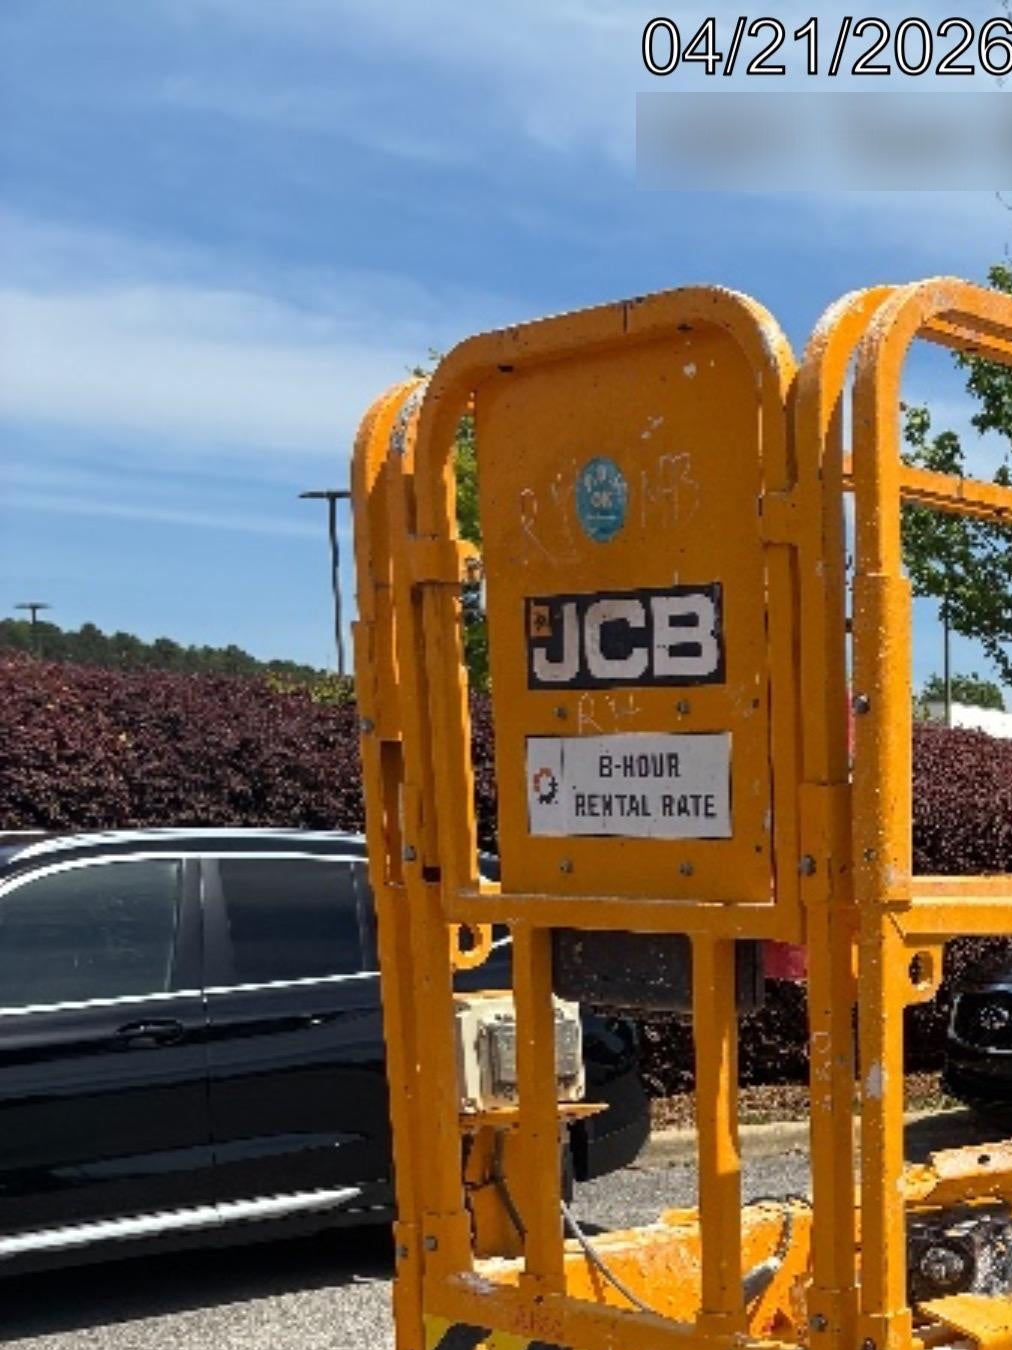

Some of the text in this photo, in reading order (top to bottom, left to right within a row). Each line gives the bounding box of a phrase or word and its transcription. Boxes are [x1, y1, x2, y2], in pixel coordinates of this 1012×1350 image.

[532, 593, 720, 682] JCB
[574, 794, 718, 819] RENTAL RATE
